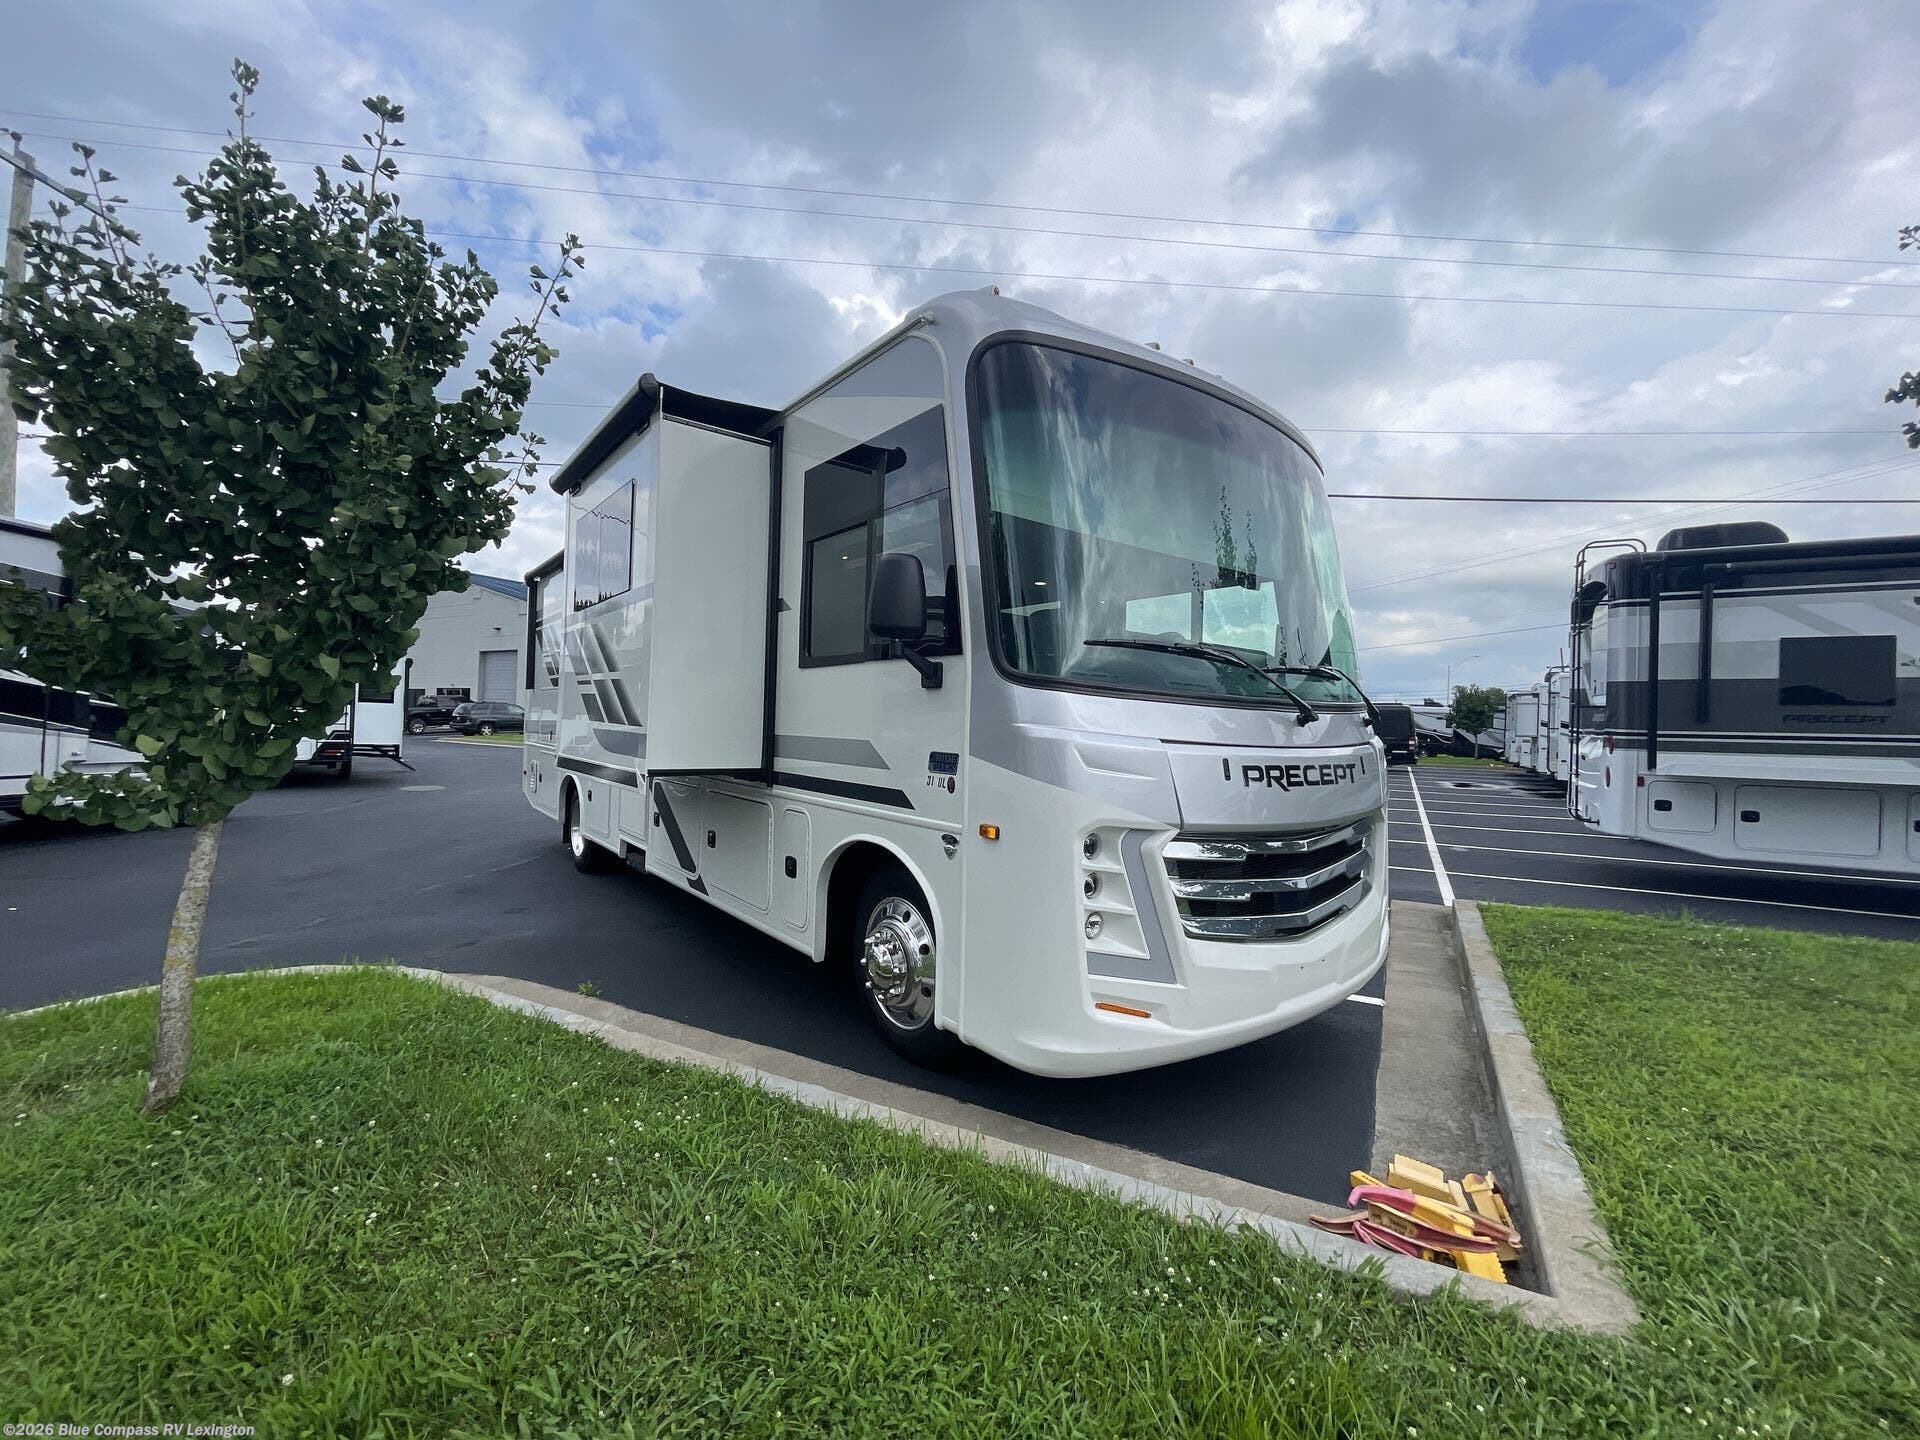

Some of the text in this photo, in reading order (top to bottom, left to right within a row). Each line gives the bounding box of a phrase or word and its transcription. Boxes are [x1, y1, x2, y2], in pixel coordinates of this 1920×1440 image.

[1783, 714, 1891, 724] PRECEPT
[926, 775, 934, 786] 31
[937, 777, 946, 788] UL
[1241, 763, 1356, 792] PRECEPT
